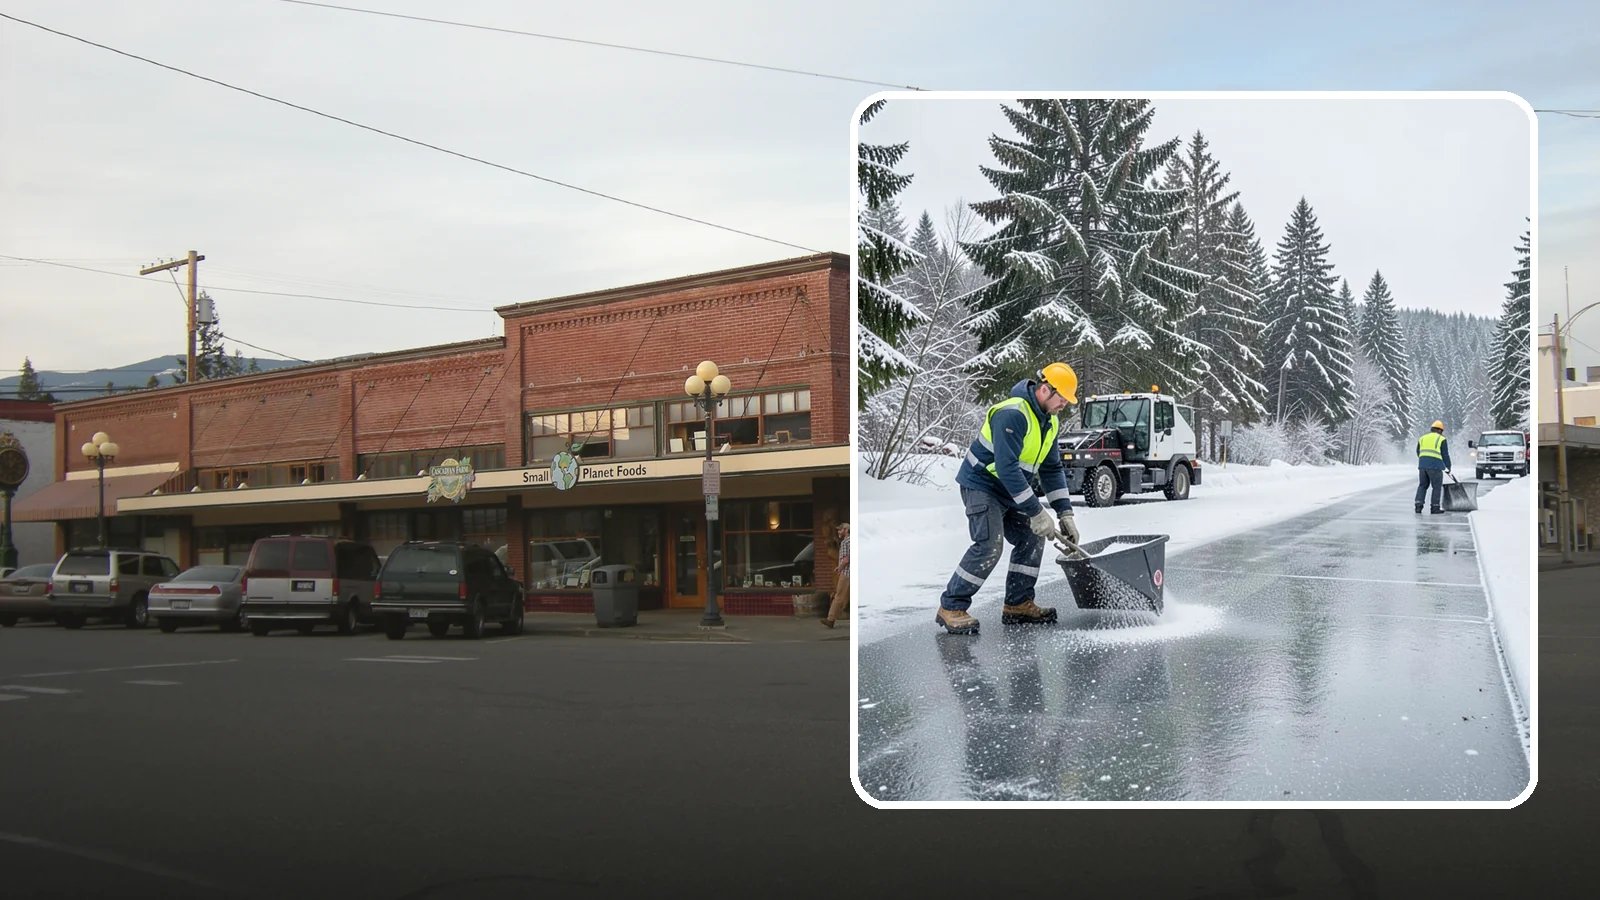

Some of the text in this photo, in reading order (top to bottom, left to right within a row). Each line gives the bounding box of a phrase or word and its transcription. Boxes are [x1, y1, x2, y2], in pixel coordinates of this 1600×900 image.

[523, 464, 647, 483] Small Planet Foods
